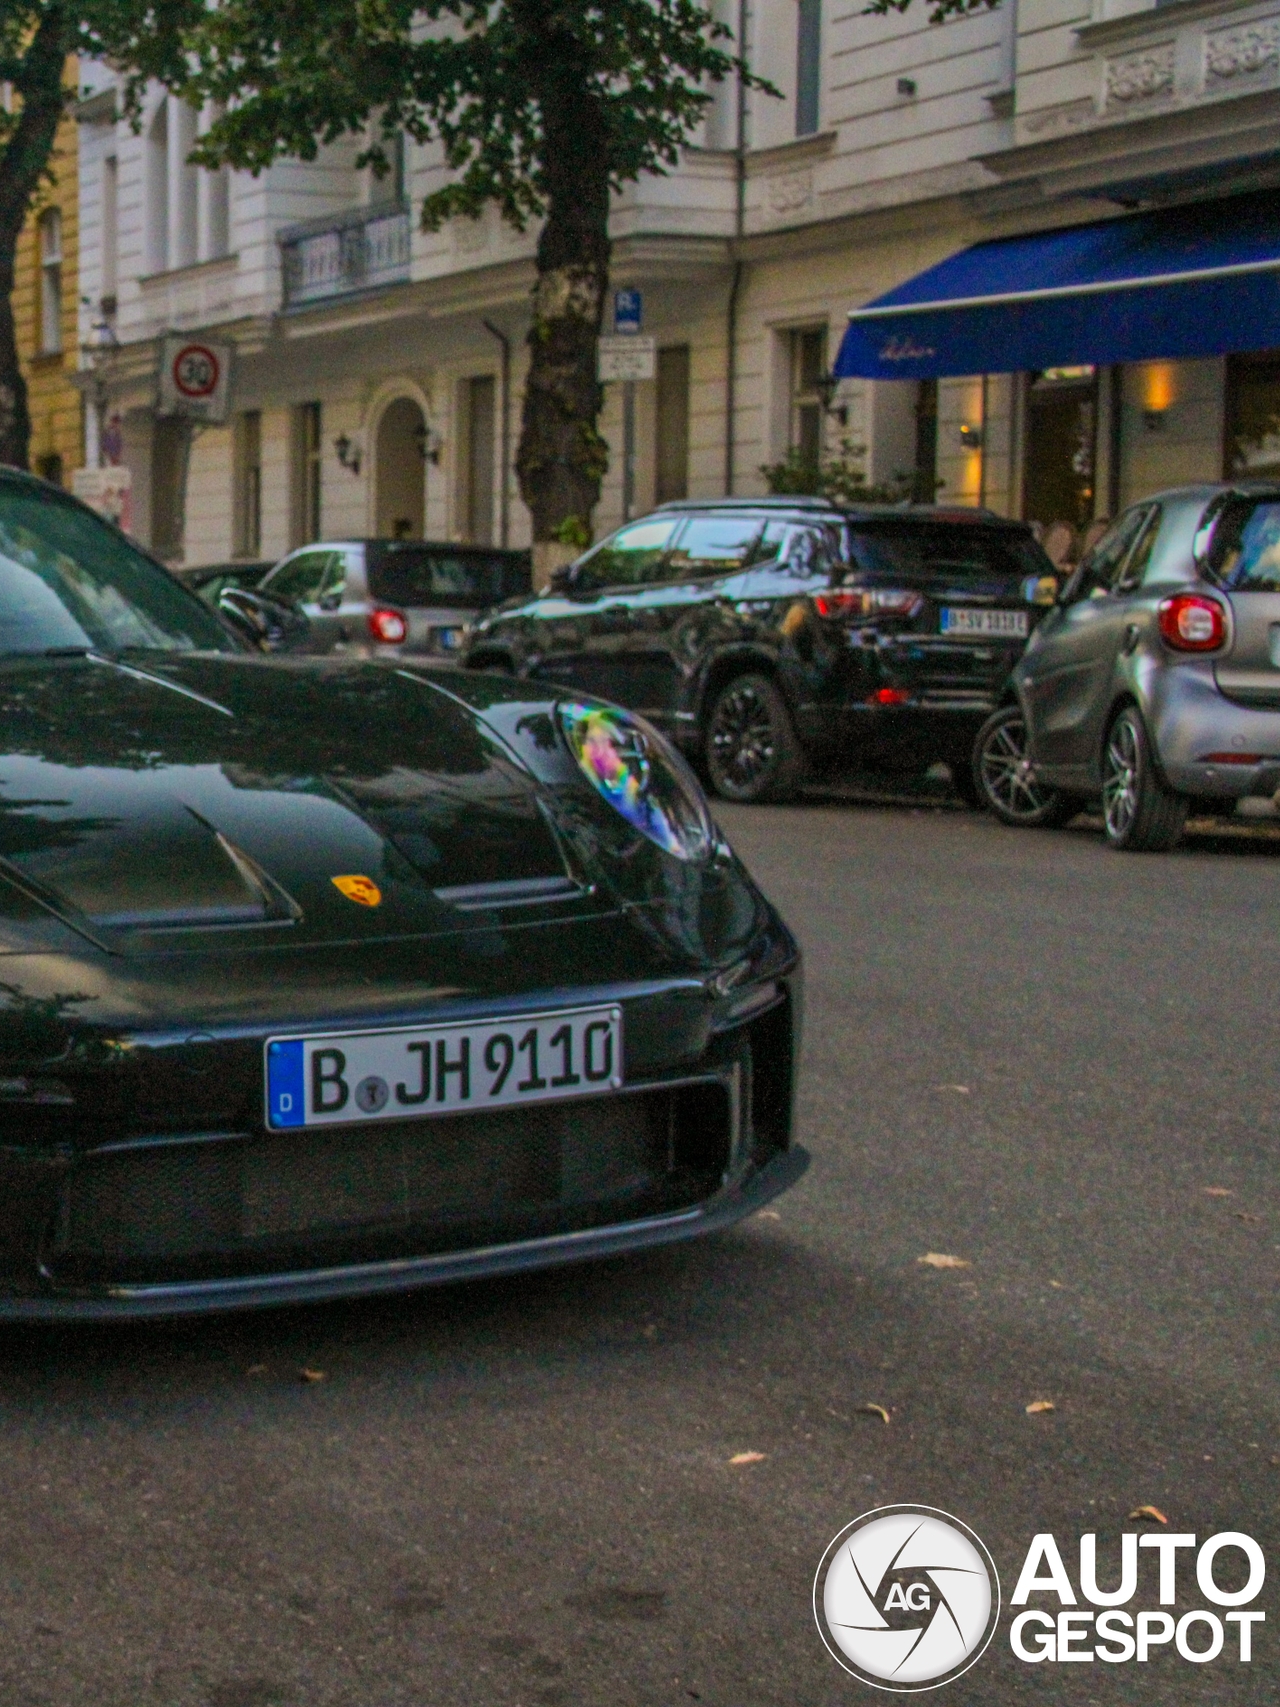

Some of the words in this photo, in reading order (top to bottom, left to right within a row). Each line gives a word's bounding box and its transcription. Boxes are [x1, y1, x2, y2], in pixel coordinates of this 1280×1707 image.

[182, 357, 210, 387] 30
[310, 1047, 350, 1115] B
[395, 1036, 470, 1106] JH
[483, 1020, 613, 1097] 9110
[279, 1094, 293, 1113] D
